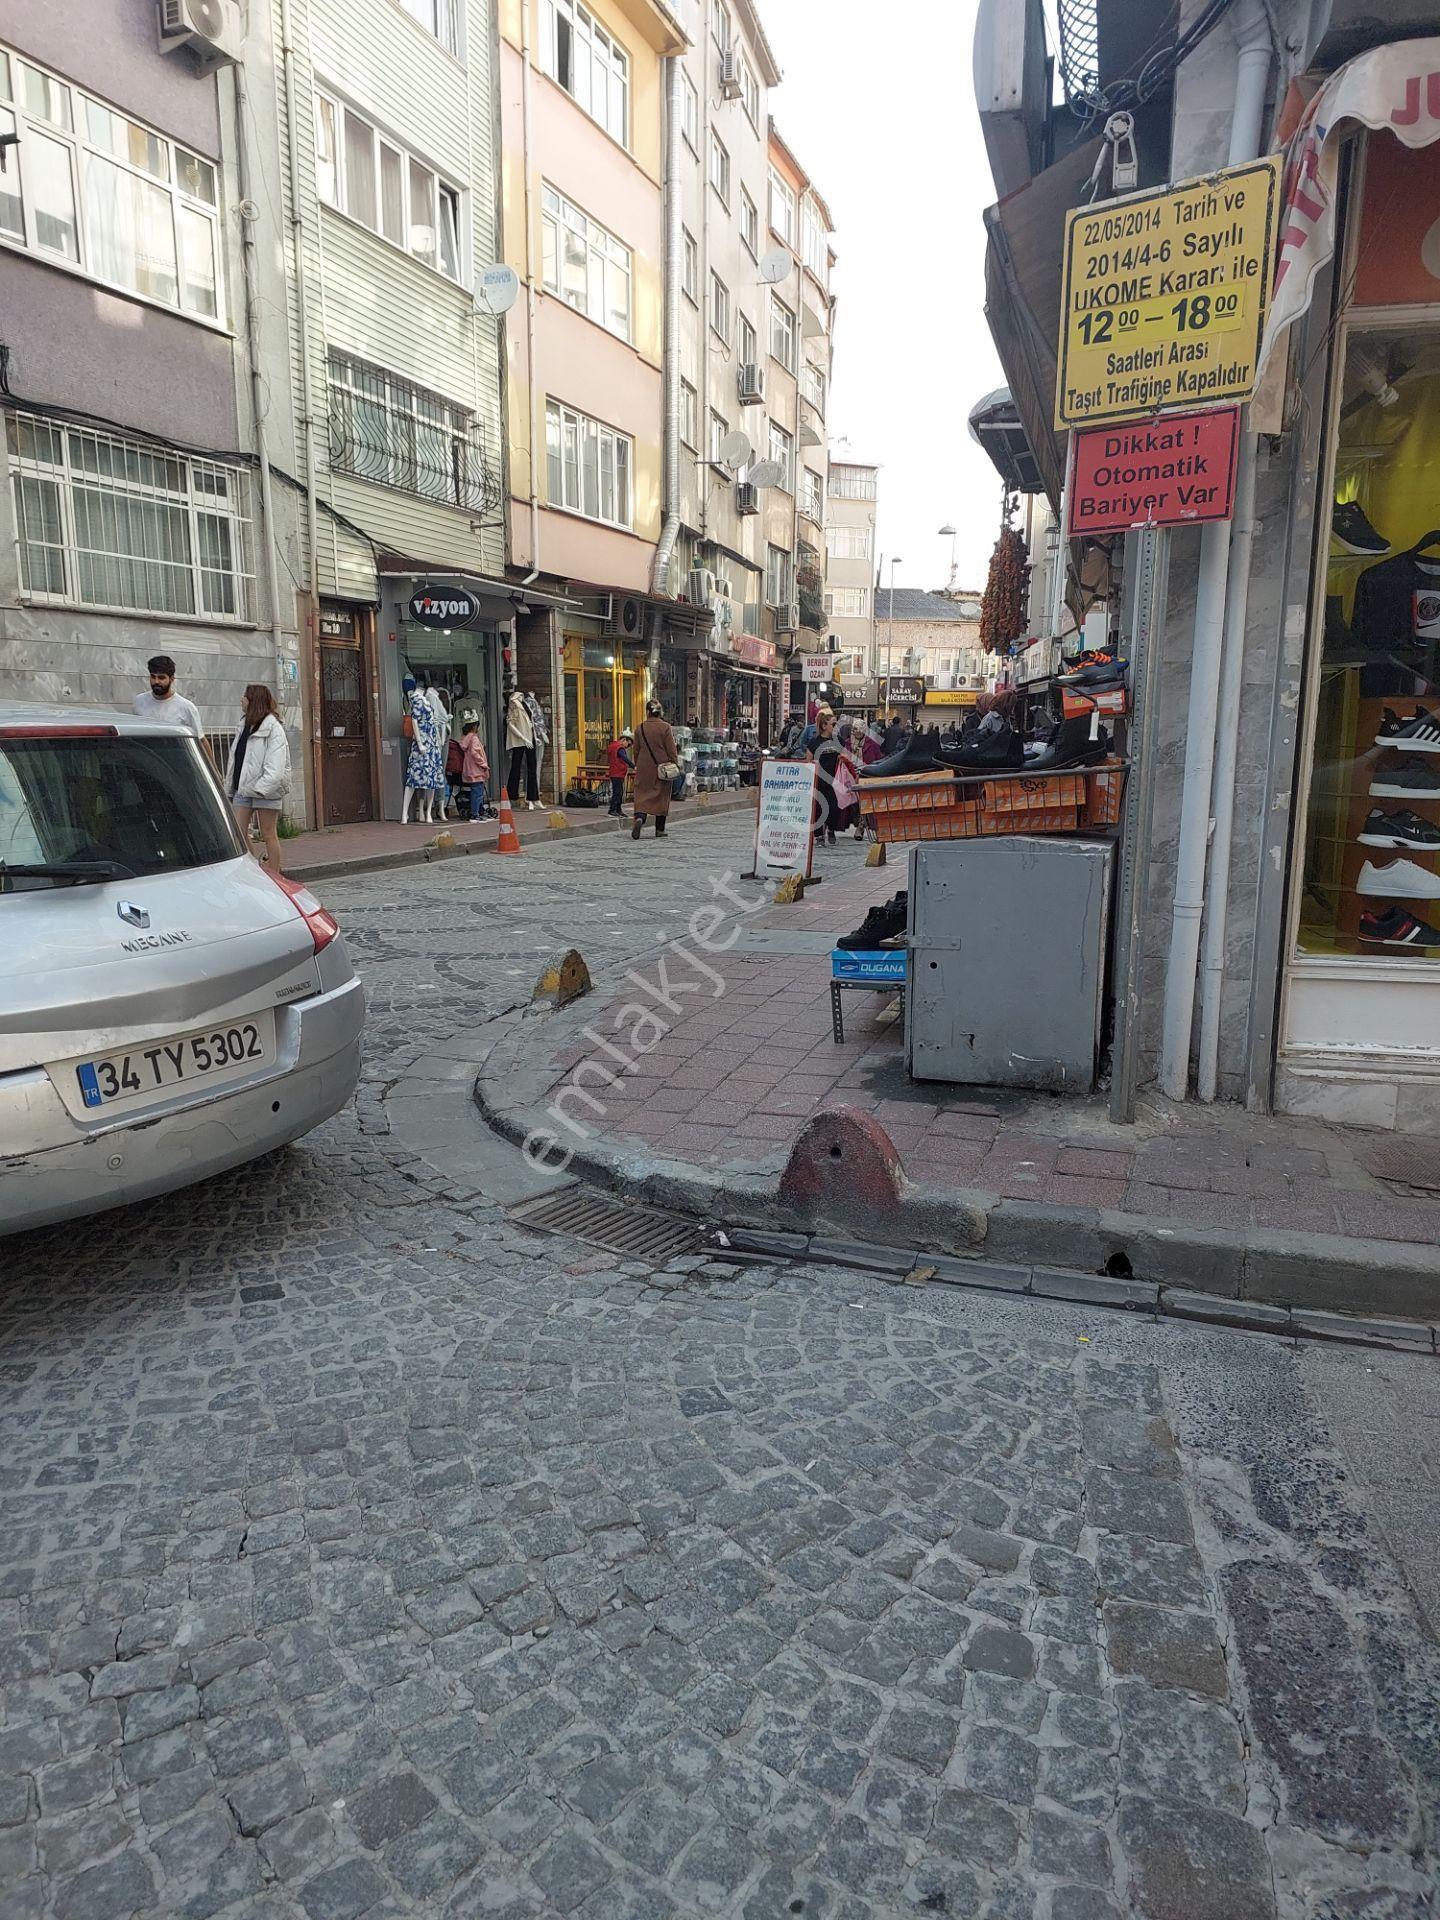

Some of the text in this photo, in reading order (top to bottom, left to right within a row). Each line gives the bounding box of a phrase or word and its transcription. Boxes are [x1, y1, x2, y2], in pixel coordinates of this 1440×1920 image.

[1084, 190, 1246, 247] 22/05/2014 Tarih ve
[1086, 222, 1243, 280] 2014/4-6 Sayılı
[1074, 275, 1153, 312] UKOME
[1232, 254, 1258, 280] ile
[1106, 344, 1164, 376] Saatleri
[1067, 361, 1250, 414] Taşıt Trafiğine Kapalıdır
[1105, 427, 1184, 458] Dikkat
[1093, 455, 1209, 488] Otomatik
[1080, 484, 1219, 518] Bariyer Var
[413, 597, 470, 618] vizyon
[806, 658, 829, 667] BERBER
[809, 670, 825, 679] OZAN
[120, 930, 193, 953] MEGANE
[97, 1024, 262, 1098] 34 TY 5302
[84, 1087, 99, 1100] TR
